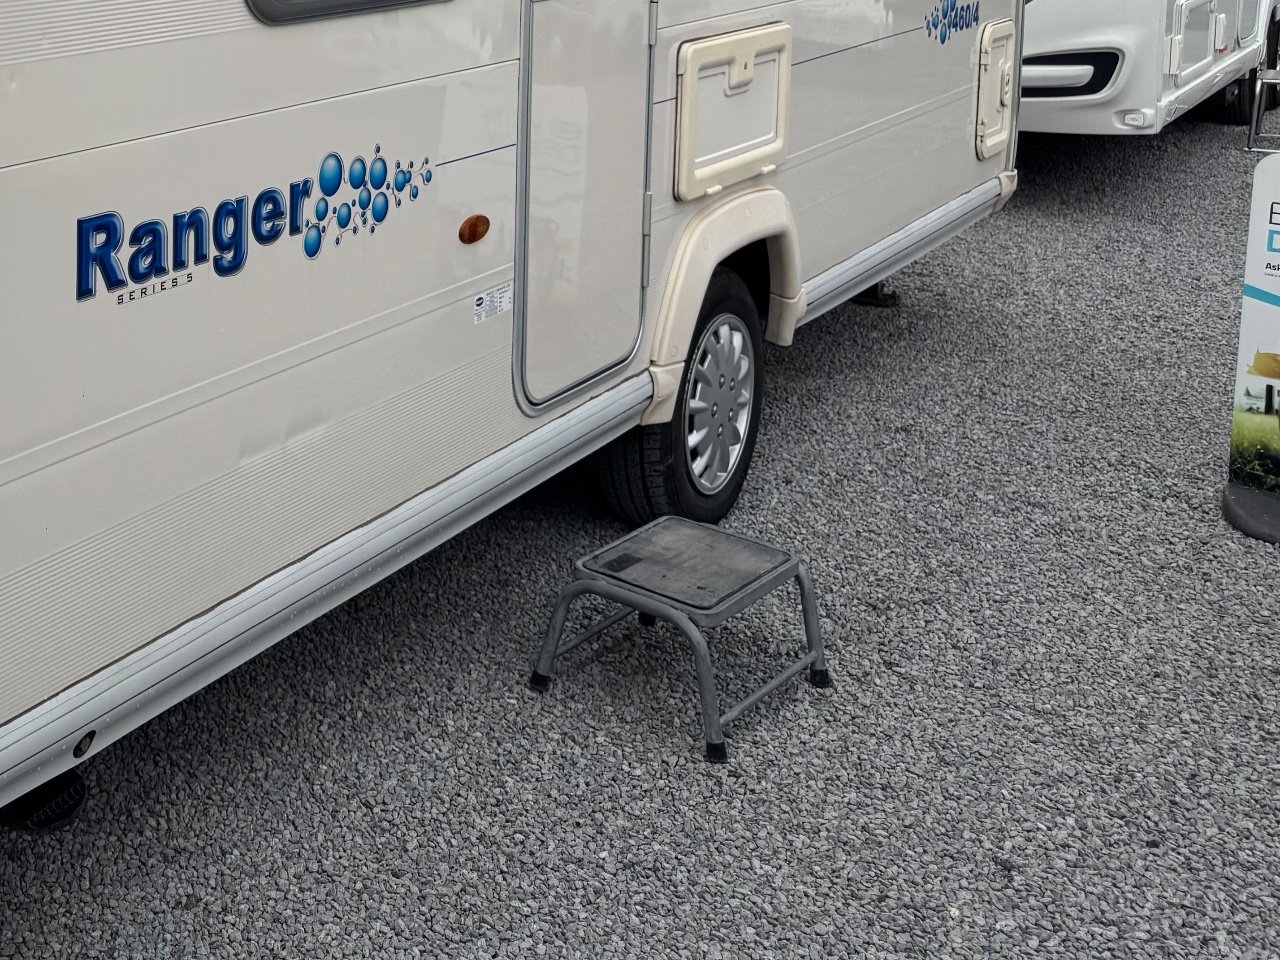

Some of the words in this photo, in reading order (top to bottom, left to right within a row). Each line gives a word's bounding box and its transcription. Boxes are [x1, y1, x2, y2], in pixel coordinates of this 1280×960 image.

[952, 1, 980, 32] 460/4
[75, 177, 314, 302] Ranger
[117, 277, 179, 305] SERIES
[186, 272, 194, 283] 5
